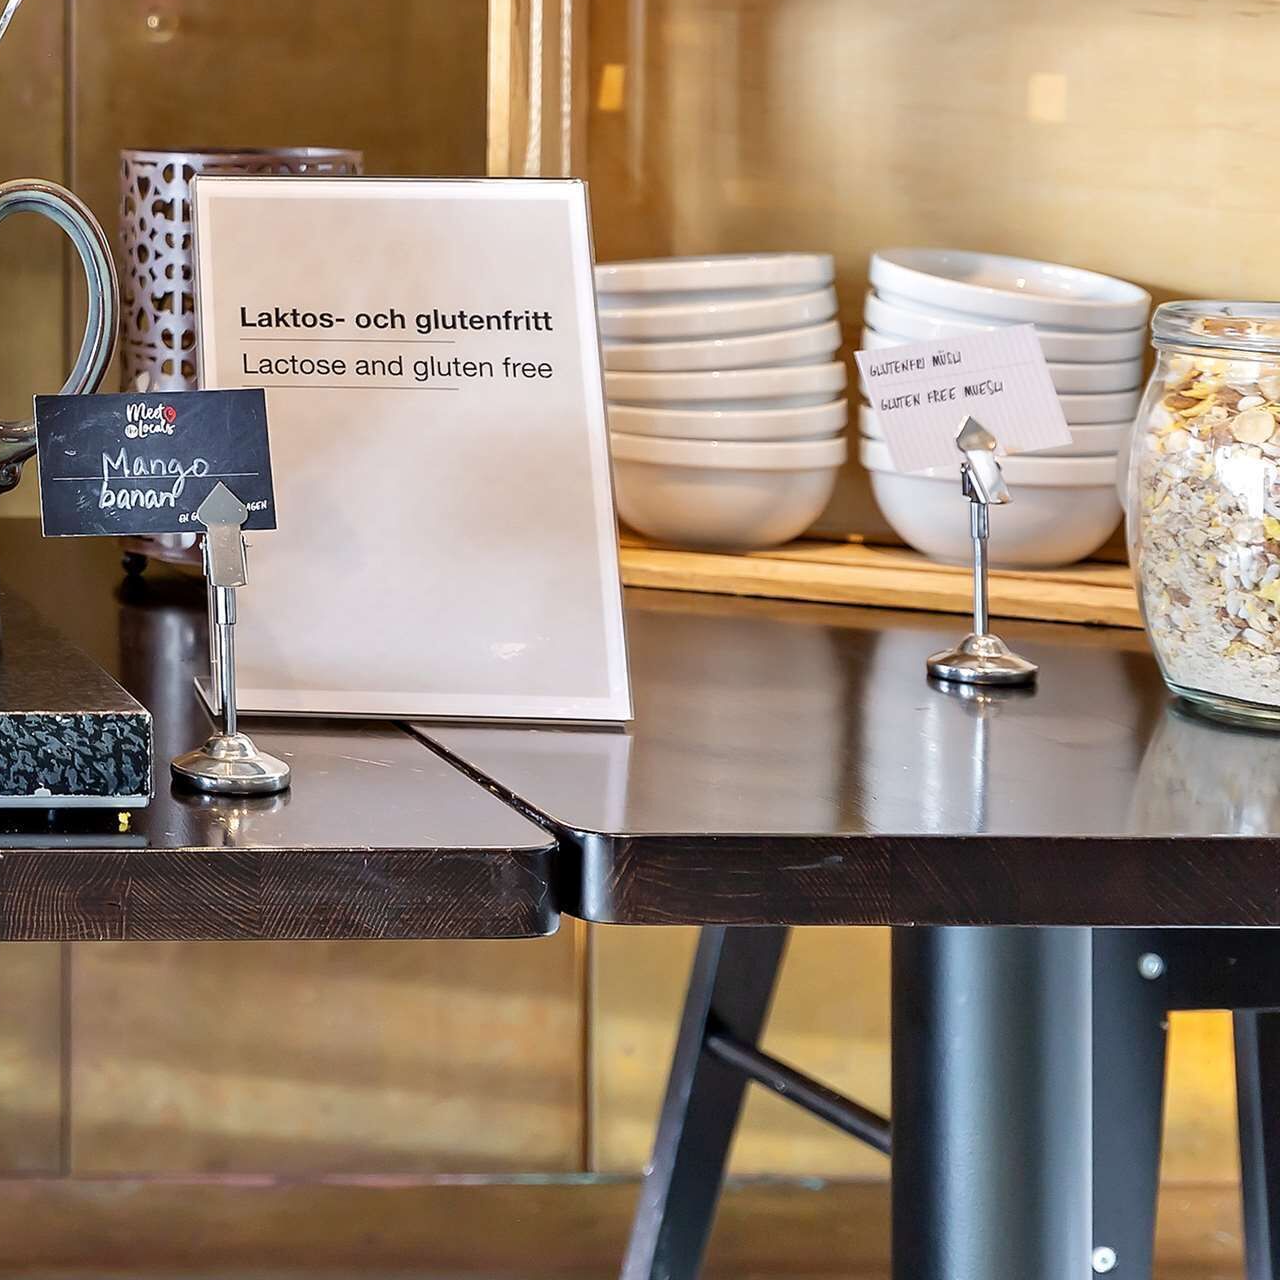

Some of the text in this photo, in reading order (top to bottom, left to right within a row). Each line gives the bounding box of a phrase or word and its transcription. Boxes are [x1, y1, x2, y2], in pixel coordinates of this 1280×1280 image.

[240, 306, 553, 335] Laktos- och glutenfritt
[242, 352, 553, 382] Lactose and gluten free
[869, 349, 962, 377] GLUTENFRI MÜSLI
[881, 379, 1004, 411] GLUTEN FREE MUESLI
[126, 402, 165, 423] Meet
[102, 447, 209, 498] Mango
[98, 481, 176, 510] banan
